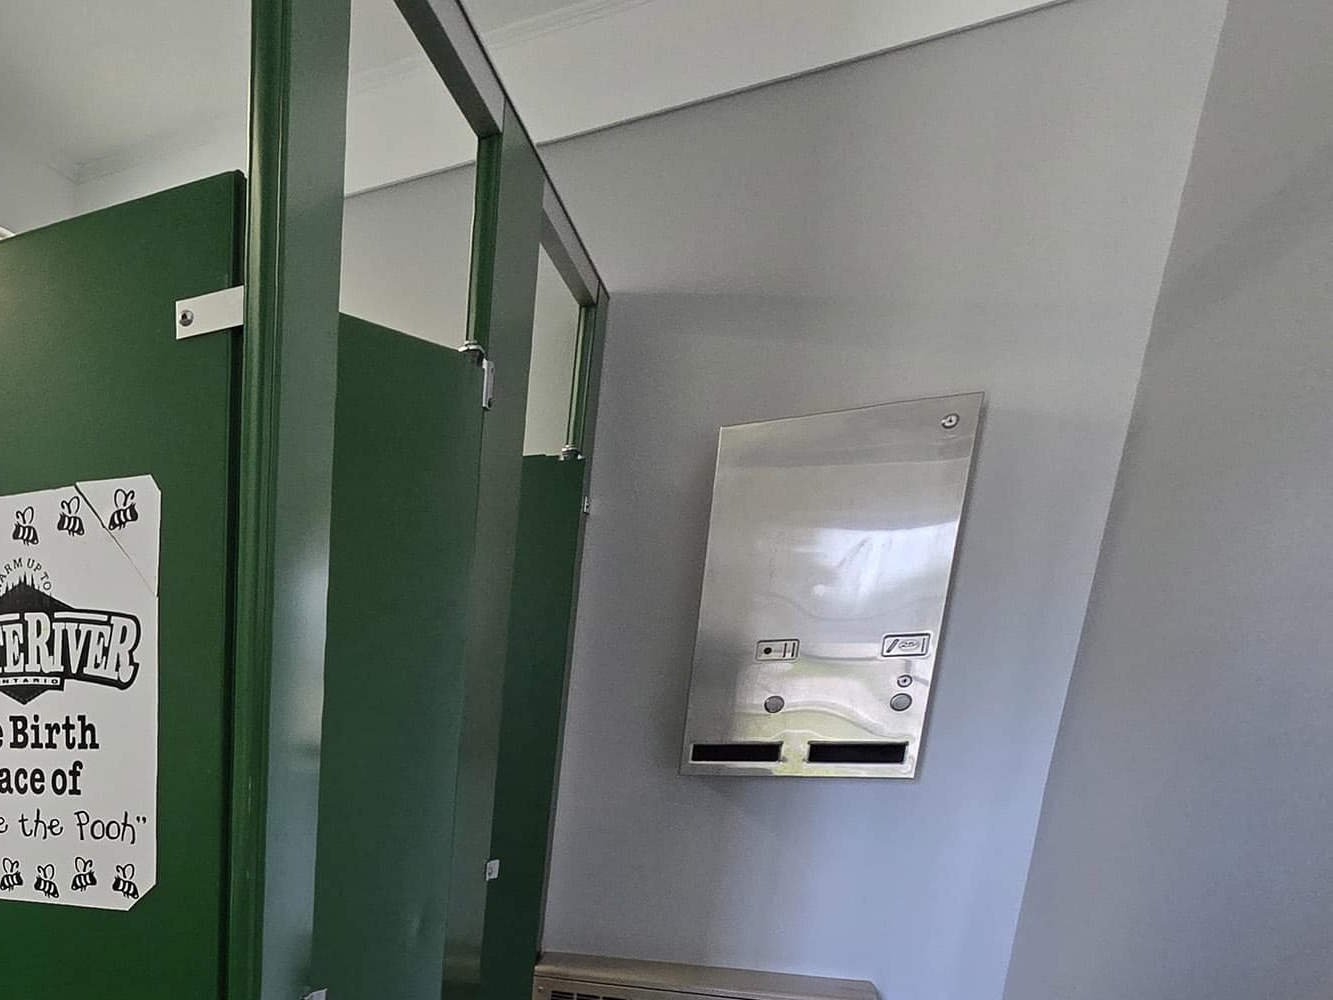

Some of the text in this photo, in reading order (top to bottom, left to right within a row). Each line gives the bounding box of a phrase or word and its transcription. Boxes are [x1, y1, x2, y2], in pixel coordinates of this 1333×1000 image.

[26, 558, 42, 572] UP
[39, 571, 52, 592] TO
[9, 714, 100, 750] Birth
[51, 760, 84, 796] of
[18, 808, 64, 840] the
